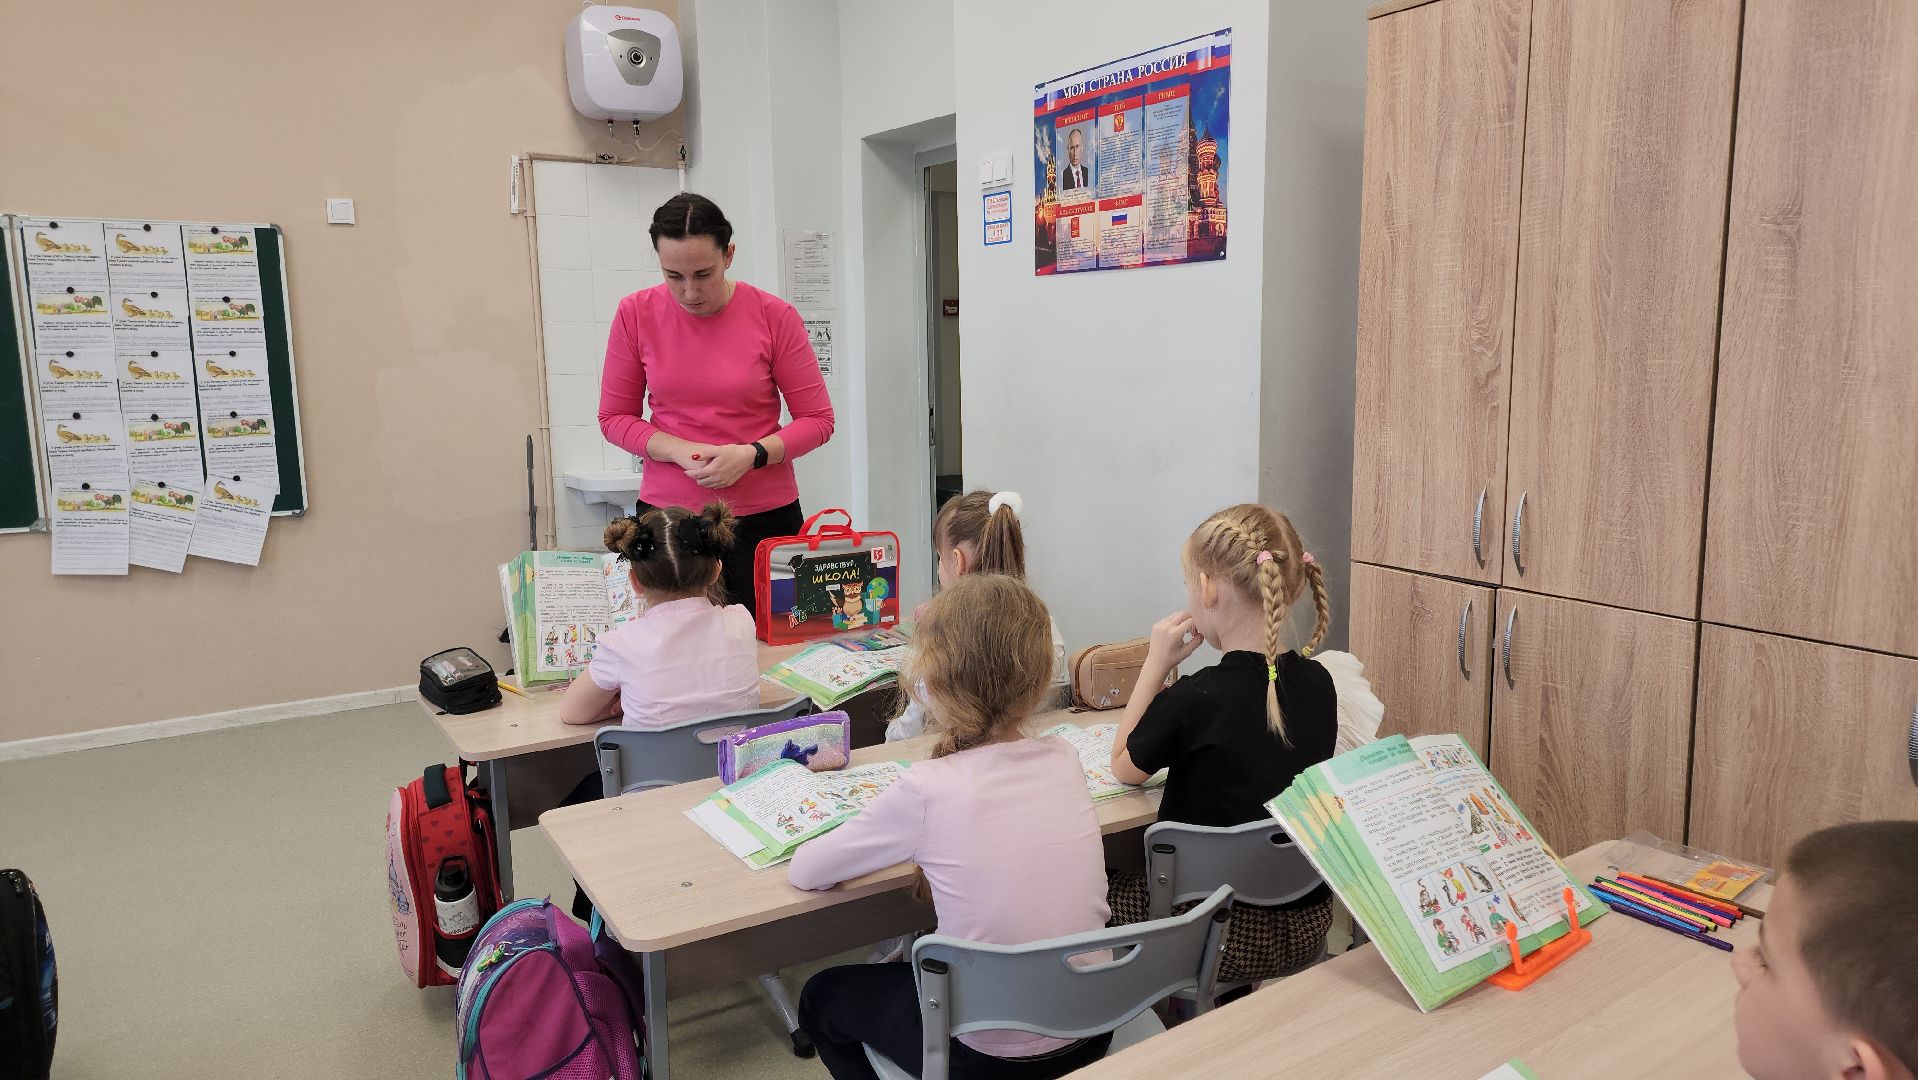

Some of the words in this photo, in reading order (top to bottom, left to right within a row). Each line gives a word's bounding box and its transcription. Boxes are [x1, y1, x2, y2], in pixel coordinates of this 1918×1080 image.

[1062, 82, 1086, 100] МОЯ
[1089, 68, 1133, 92] СТРАНА
[1138, 52, 1187, 79] РОССИЯ
[812, 567, 860, 585] ШКОЛА!
